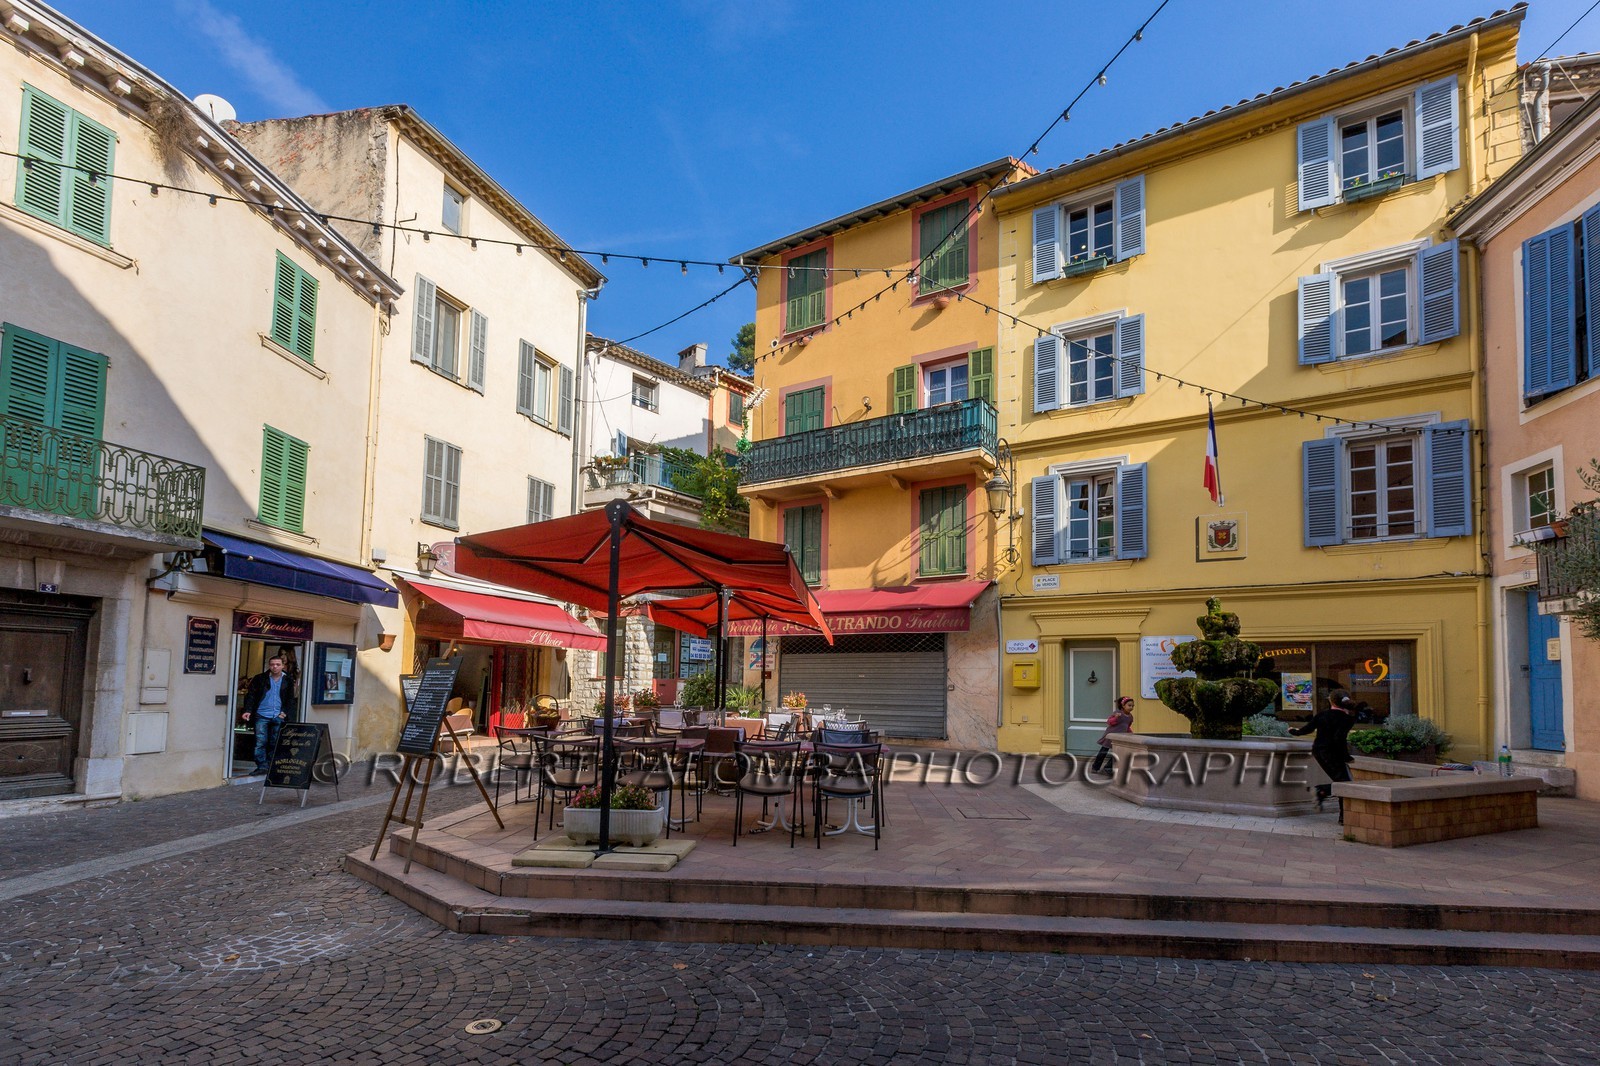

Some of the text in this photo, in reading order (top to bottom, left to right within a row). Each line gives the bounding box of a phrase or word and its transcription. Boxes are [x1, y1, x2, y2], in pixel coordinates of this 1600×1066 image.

[245, 613, 305, 633] Bijouterie
[727, 619, 778, 633] Boucheie
[906, 613, 966, 629] Traiteur
[526, 630, 563, 646] L'Olivier
[1265, 648, 1307, 657] CITOYEN
